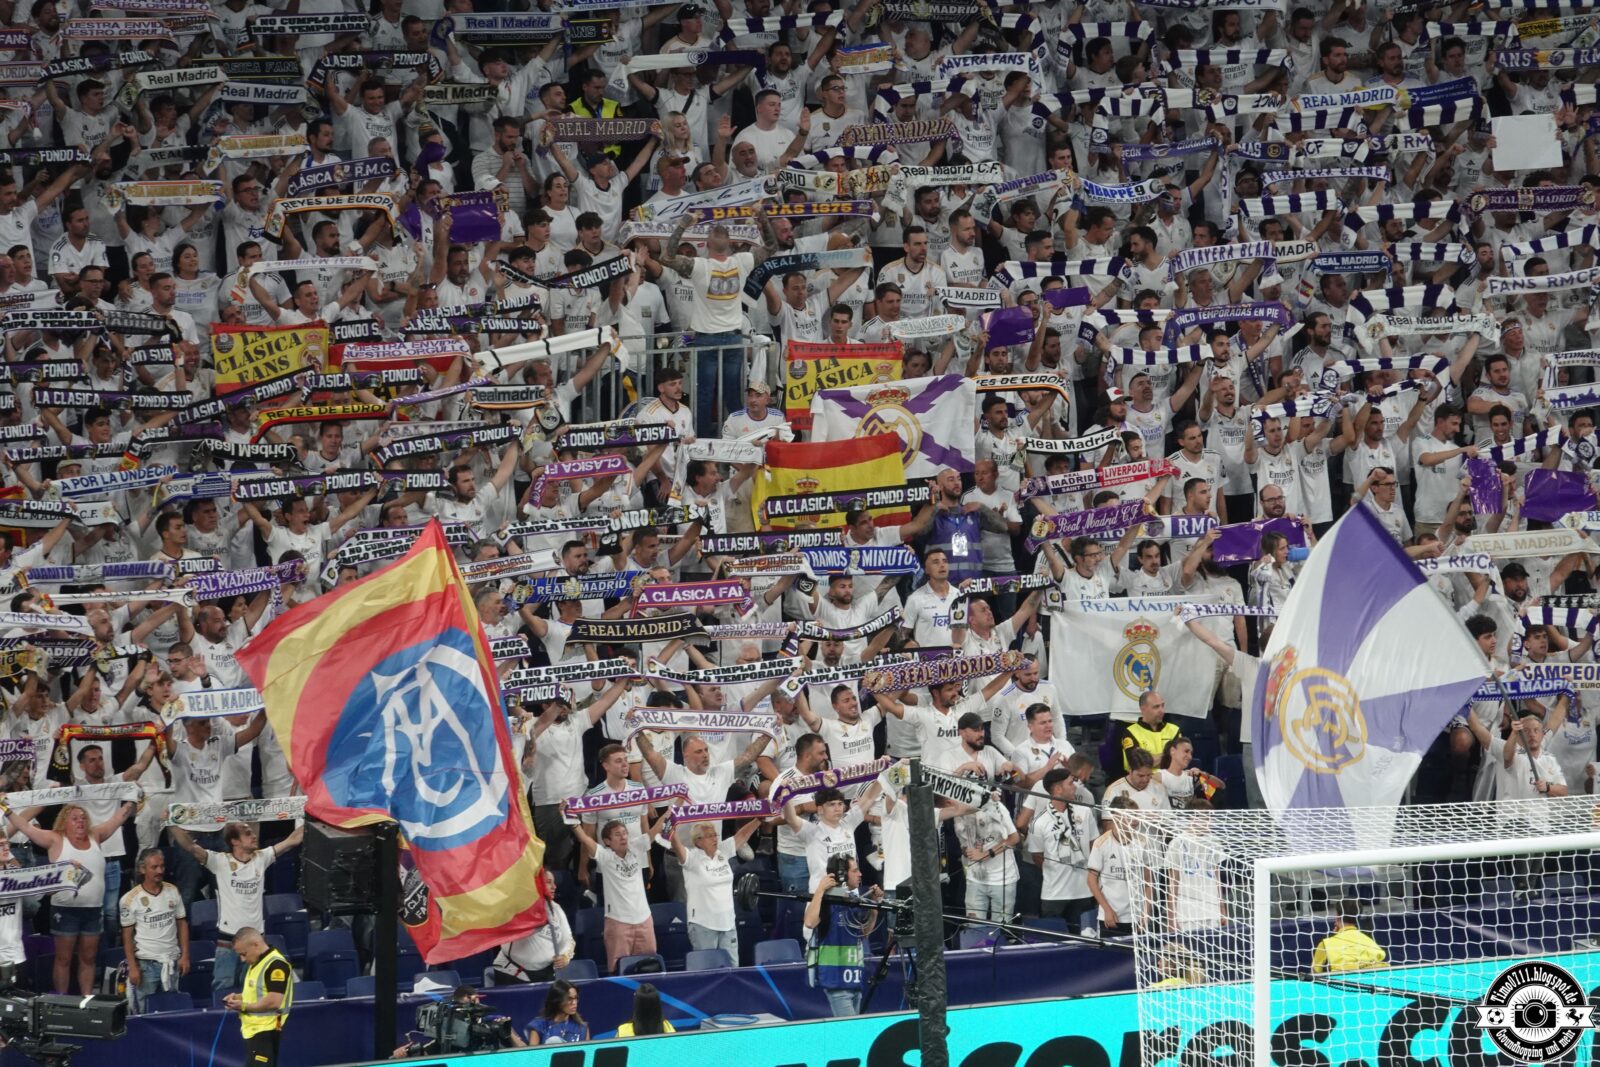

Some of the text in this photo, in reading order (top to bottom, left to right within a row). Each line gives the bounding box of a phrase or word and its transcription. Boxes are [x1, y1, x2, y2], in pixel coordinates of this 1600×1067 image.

[288, 22, 368, 33] TEMPORADAS
[502, 16, 551, 28] Madrid
[1498, 51, 1531, 66] ANS
[1341, 87, 1394, 105] MADRID
[595, 120, 647, 134] MADRID
[995, 172, 1057, 194] CAMPEONES
[347, 195, 394, 210] EUROPA
[713, 203, 808, 219] BARJAS
[1490, 275, 1540, 293] FANS
[1197, 308, 1251, 320] TEMPORADAS
[217, 333, 302, 375] CLÁSICA
[238, 355, 289, 384] FANS
[789, 362, 874, 400] CLÁSICA
[53, 392, 100, 406] CLASICA
[179, 400, 226, 426] CLASICA
[268, 408, 313, 419] REYES
[1062, 431, 1115, 450] Madrid
[250, 480, 295, 497] CLASICA
[786, 497, 834, 512] CLASICA
[1514, 535, 1573, 549] MADRID
[862, 549, 912, 567] MINUTO
[580, 580, 627, 593] MADRID
[653, 588, 714, 603] CLÁSICA
[1080, 599, 1185, 612] REAL MADRI
[627, 621, 681, 636] MADRID
[544, 664, 595, 675] CUMPLO
[659, 665, 796, 682] CUMPLO TEMPORADAS
[938, 654, 995, 679] MADRID
[504, 667, 637, 690] CUMPLO TEMPORADAS
[699, 714, 749, 727] MADRID
[839, 760, 886, 780] MADRID
[588, 789, 648, 807] CLASICA
[243, 801, 292, 815] Madrid
[1, 870, 62, 891] Madrid
